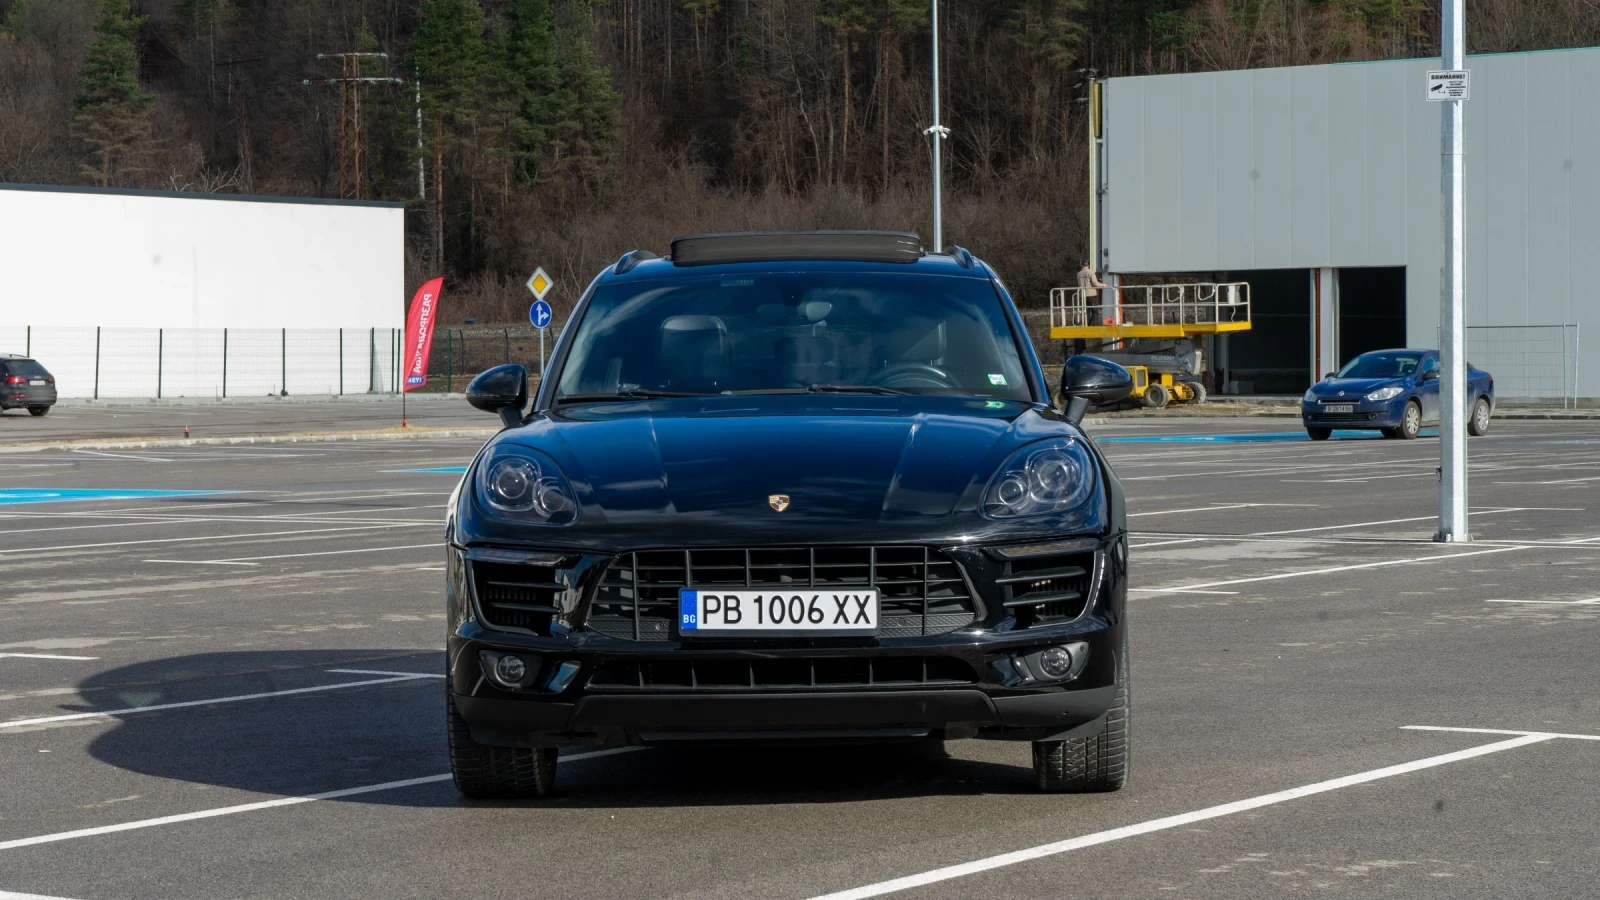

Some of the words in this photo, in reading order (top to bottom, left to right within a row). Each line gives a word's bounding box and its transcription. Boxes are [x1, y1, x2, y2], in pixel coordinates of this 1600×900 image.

[683, 614, 696, 623] BG
[703, 595, 742, 624] PB
[753, 595, 825, 624] 1006
[832, 594, 871, 624] XX
